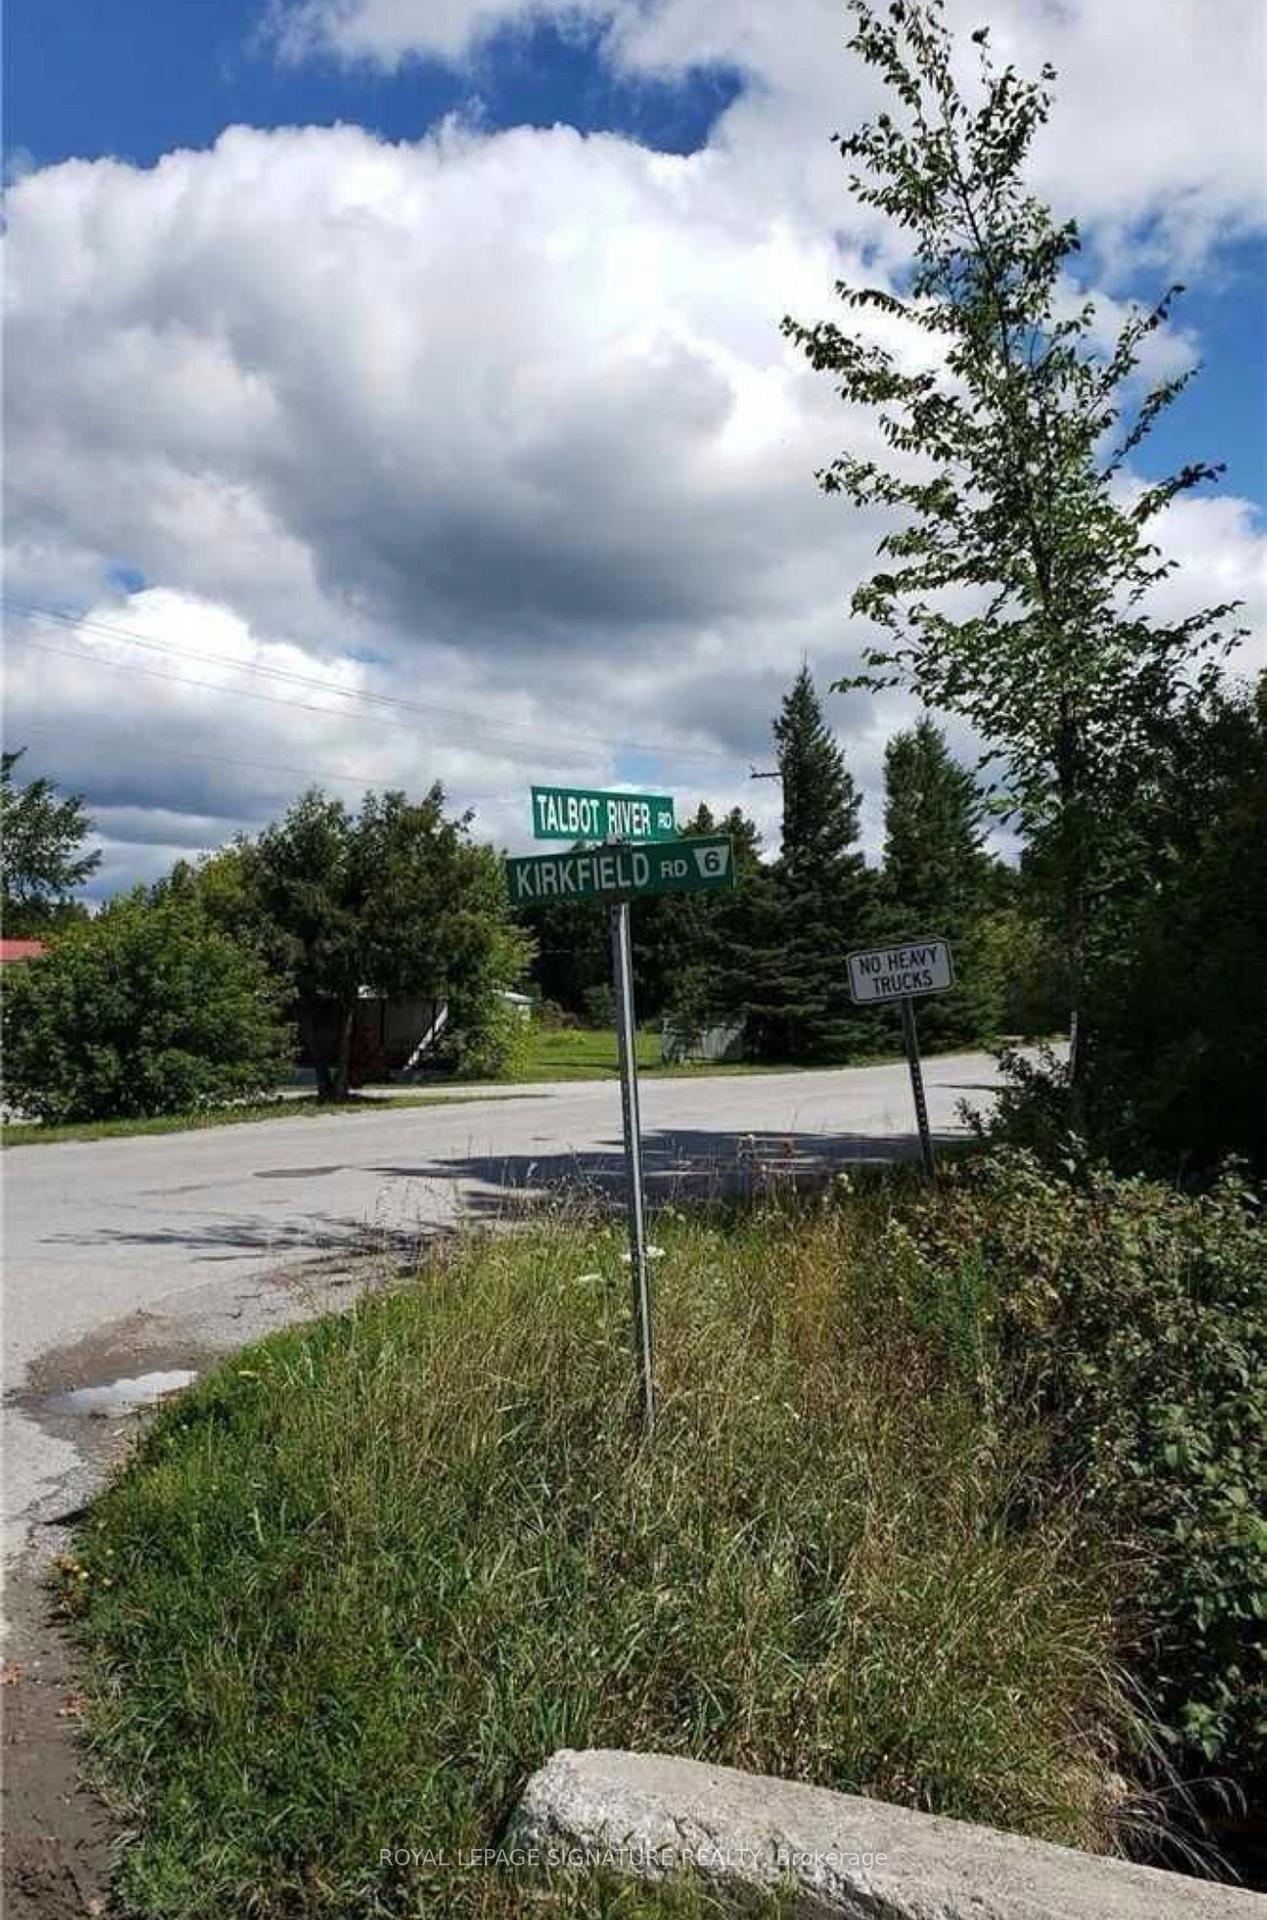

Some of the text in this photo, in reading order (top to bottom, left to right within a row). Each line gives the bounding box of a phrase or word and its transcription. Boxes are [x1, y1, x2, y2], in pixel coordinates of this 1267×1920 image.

[537, 794, 672, 835] TALBOT RIVER RD
[516, 850, 721, 897] KIRKFIELD RD 6
[859, 946, 937, 975] NO HEAVY
[872, 969, 933, 993] TRUCKS
